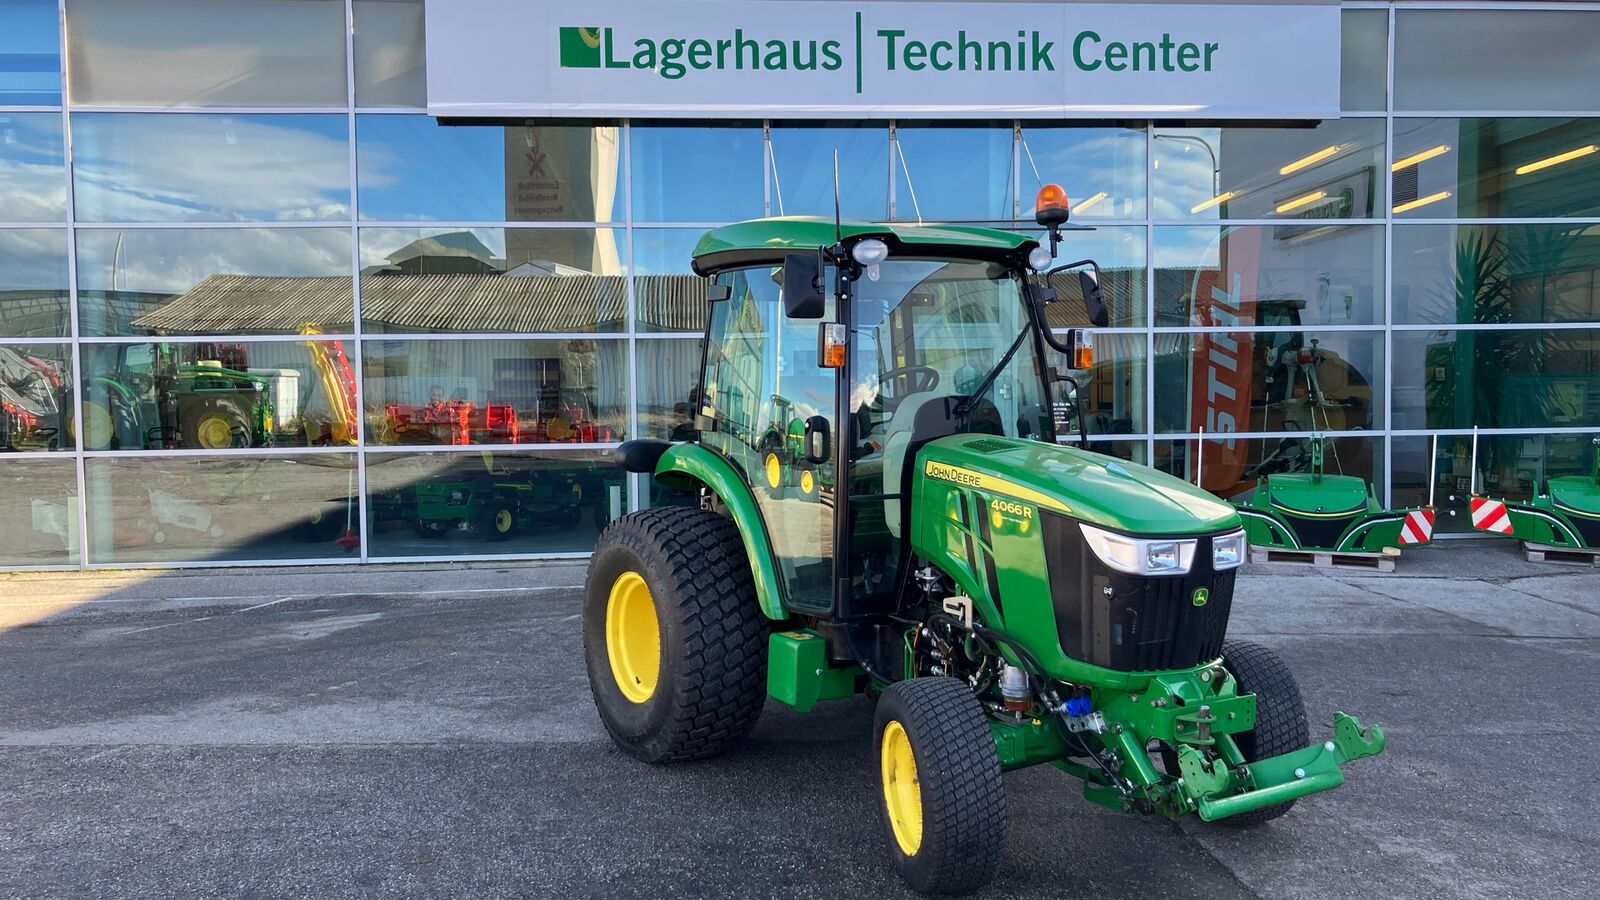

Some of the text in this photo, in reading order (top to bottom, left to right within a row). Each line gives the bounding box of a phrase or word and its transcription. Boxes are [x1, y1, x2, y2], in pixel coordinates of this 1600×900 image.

[604, 27, 1219, 79] Lagerhaus Technik Center
[1207, 272, 1241, 450] STIHL
[991, 499, 1032, 519] 4066R
